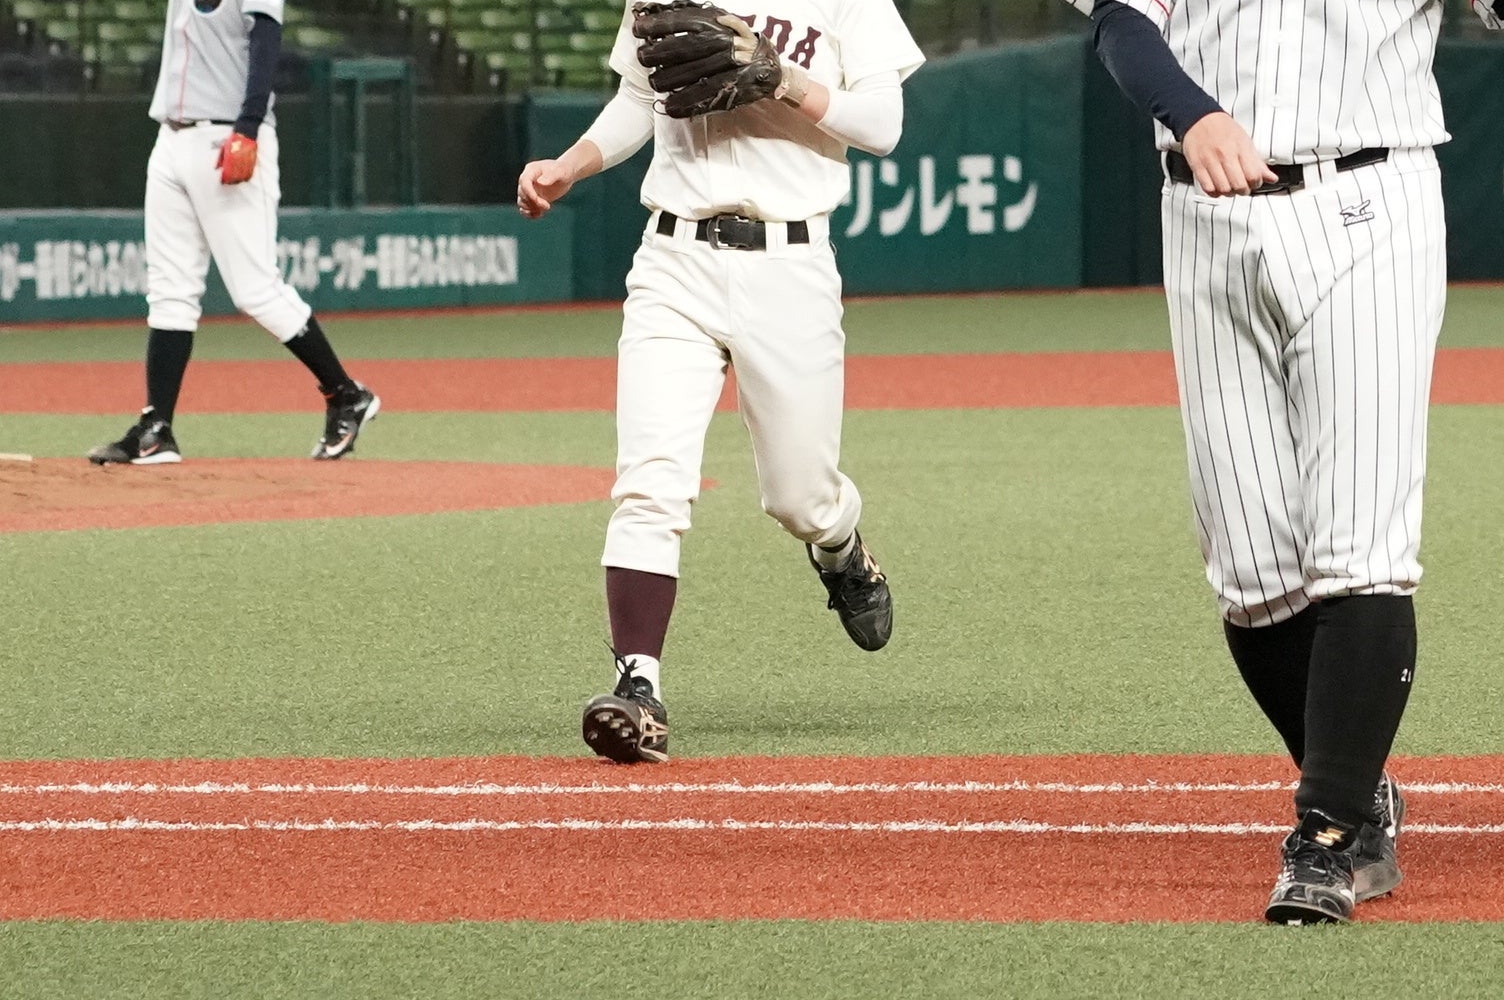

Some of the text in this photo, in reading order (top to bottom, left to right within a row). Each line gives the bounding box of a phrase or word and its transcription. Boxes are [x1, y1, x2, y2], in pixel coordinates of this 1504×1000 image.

[840, 153, 1039, 239] リンレモン
